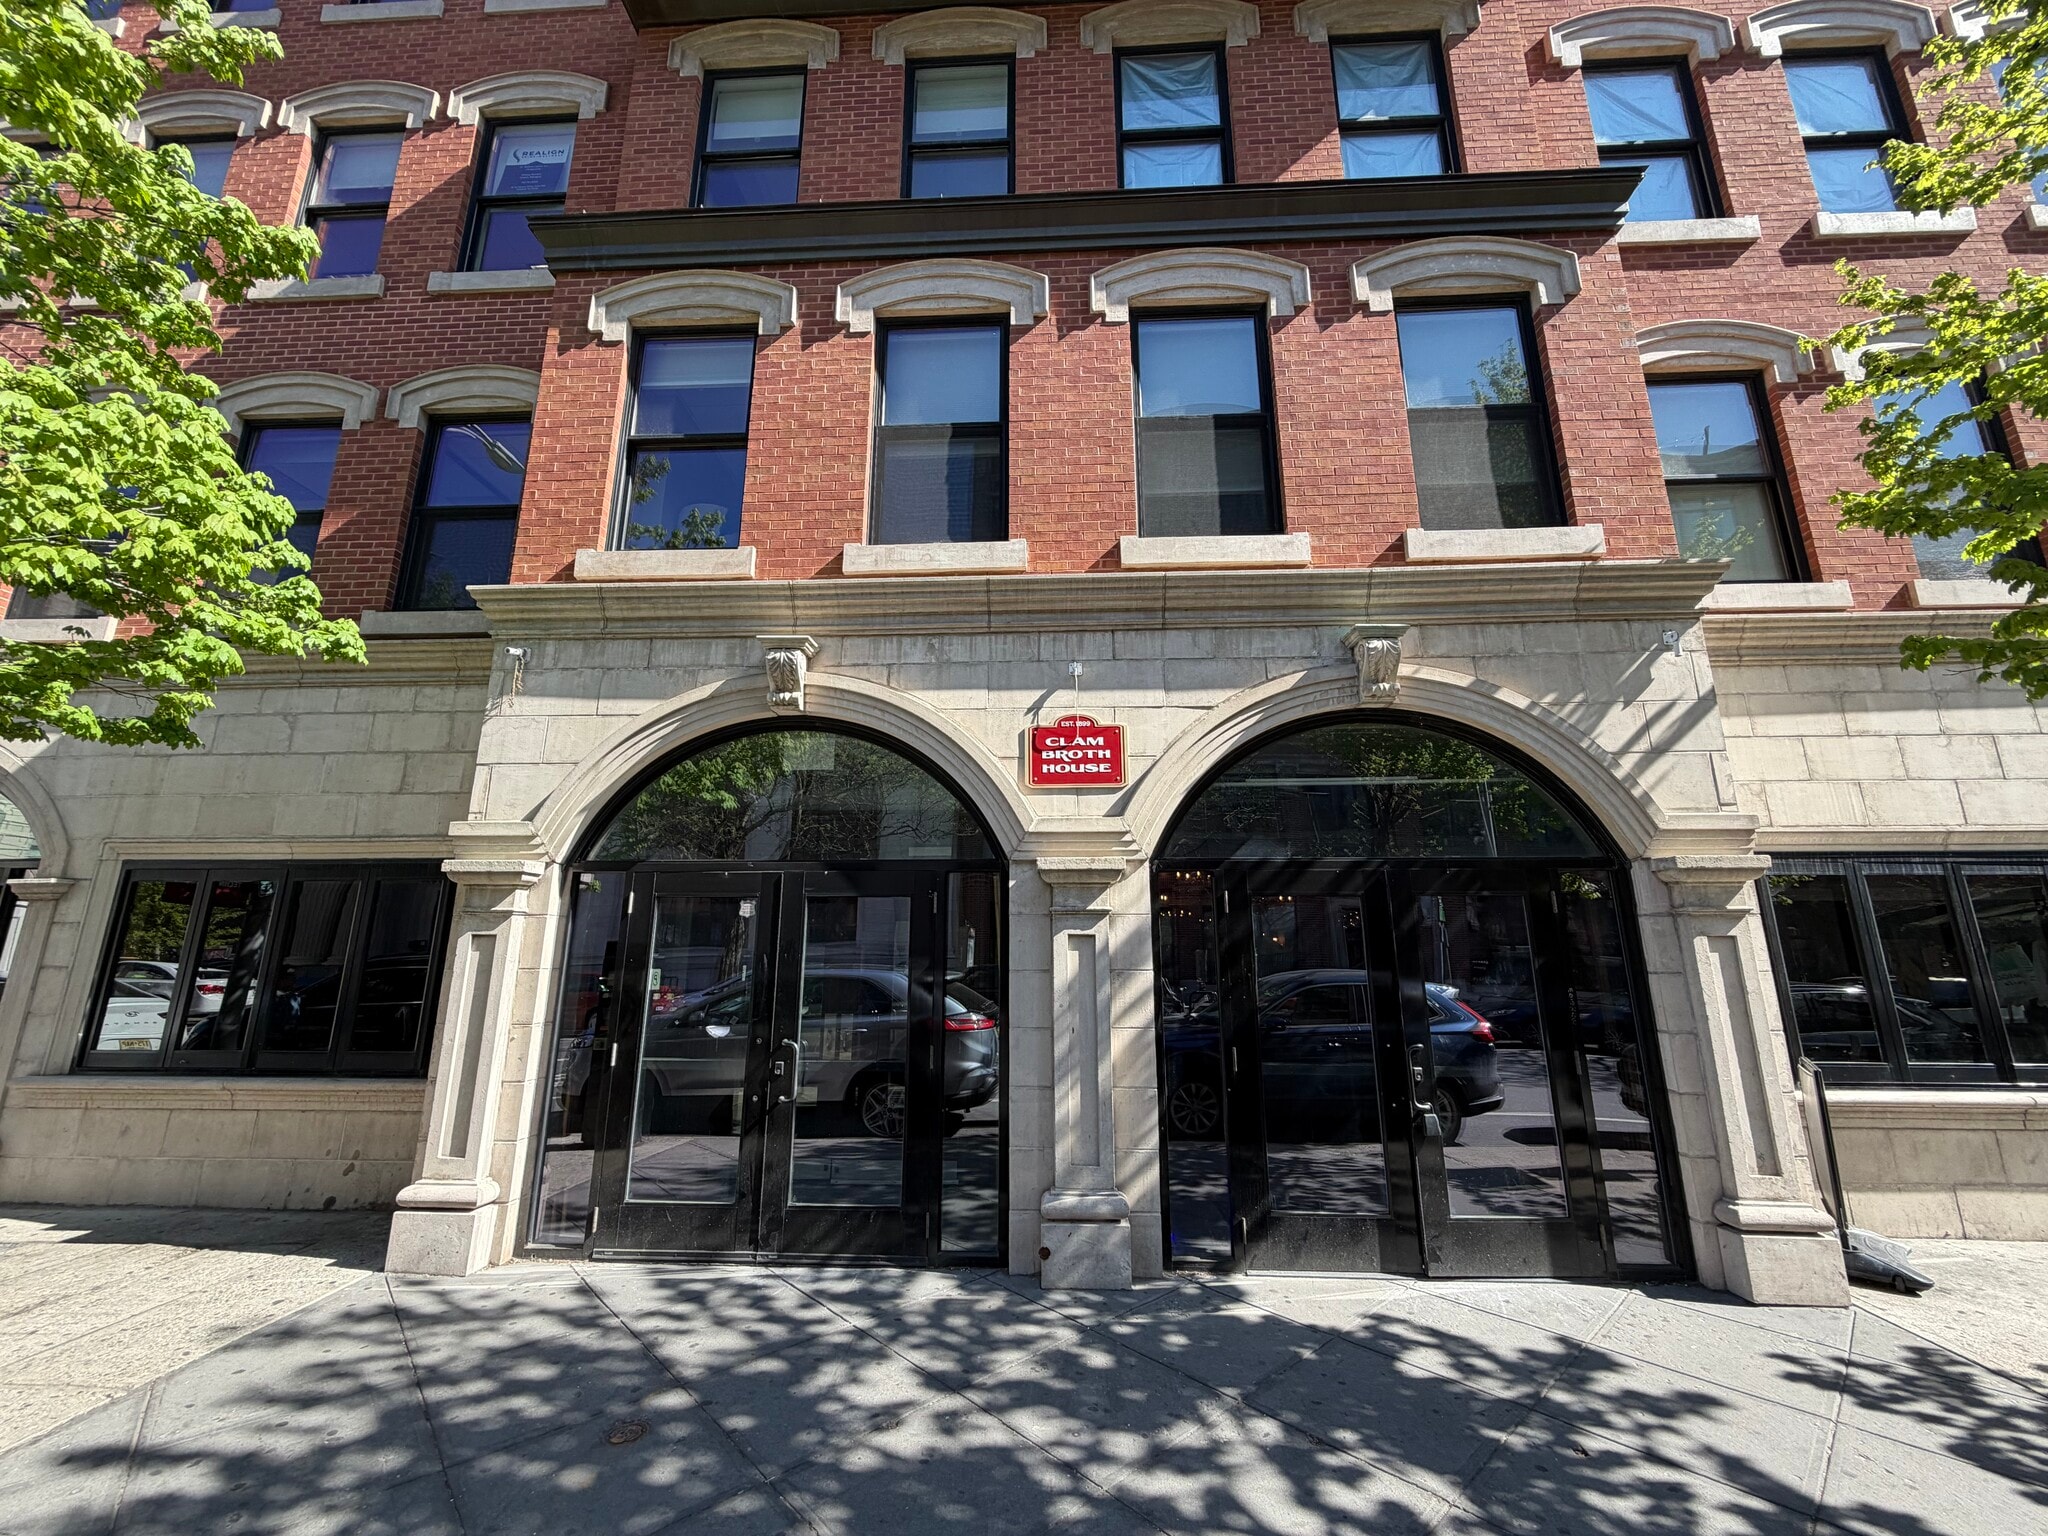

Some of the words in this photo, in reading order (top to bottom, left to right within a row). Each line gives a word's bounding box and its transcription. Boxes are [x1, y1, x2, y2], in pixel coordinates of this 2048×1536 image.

[1045, 737, 1104, 746] CLAM
[1042, 750, 1111, 762] BROTH
[1042, 763, 1112, 773] HOUSE
